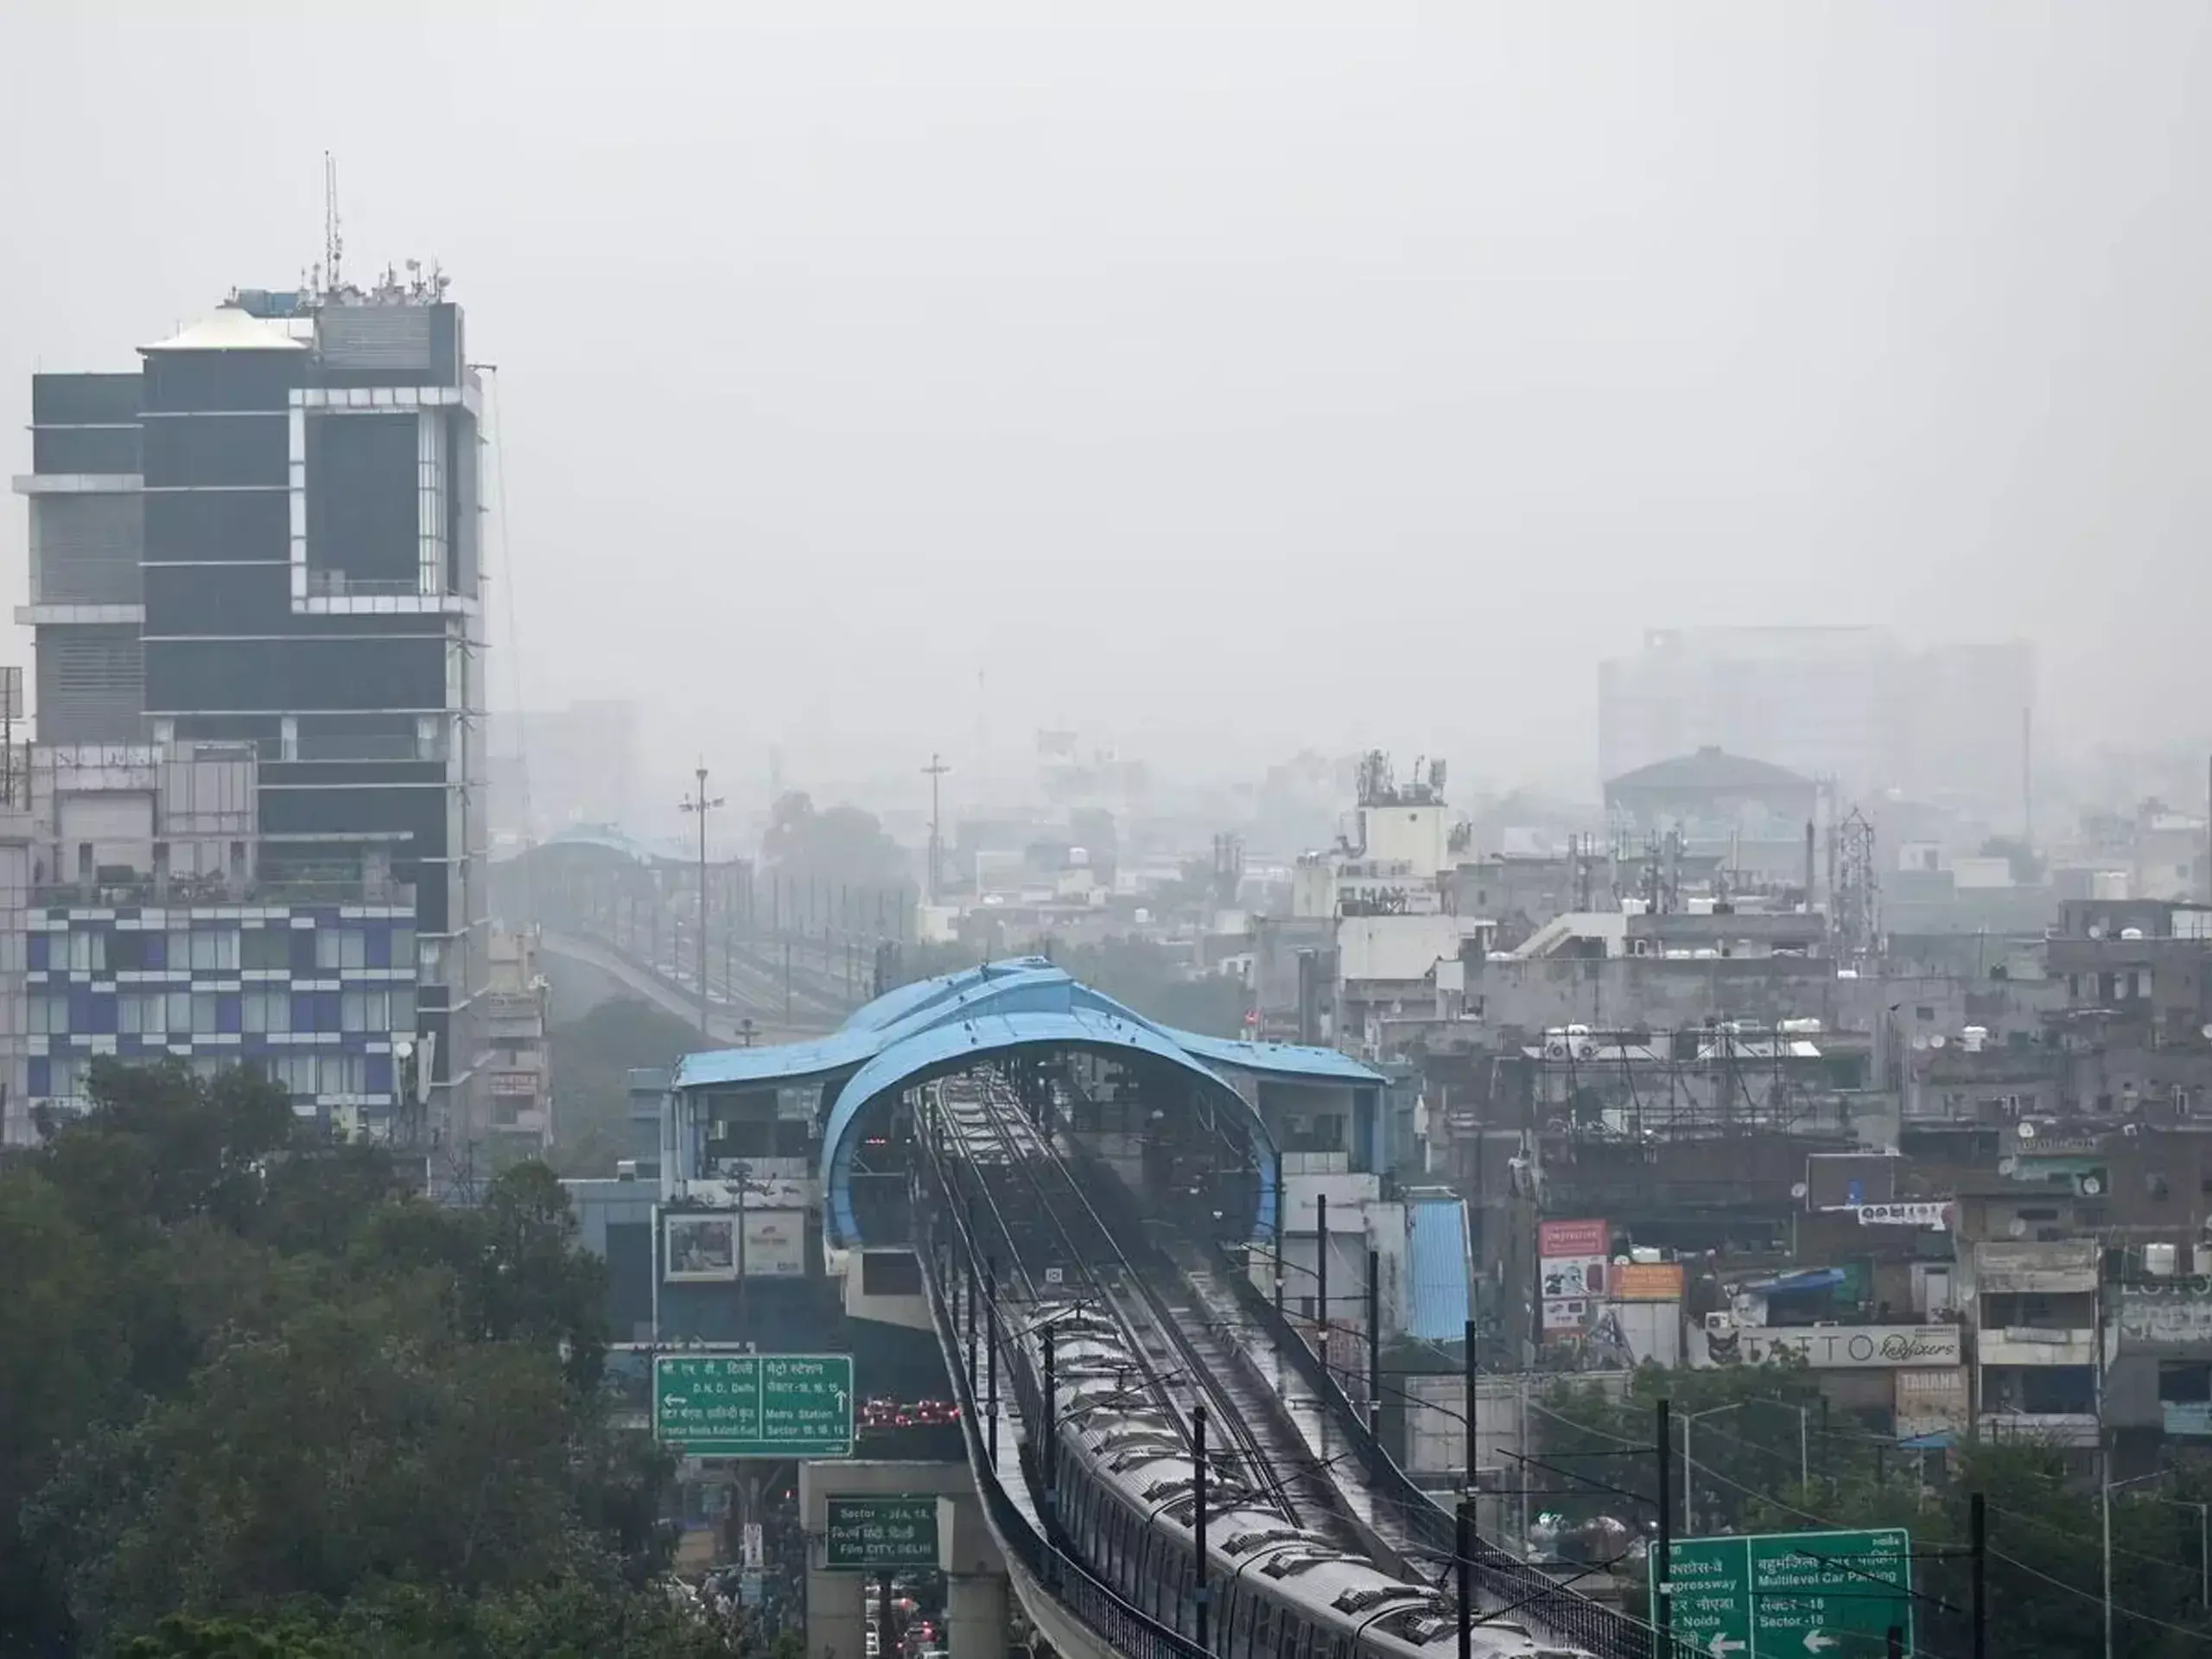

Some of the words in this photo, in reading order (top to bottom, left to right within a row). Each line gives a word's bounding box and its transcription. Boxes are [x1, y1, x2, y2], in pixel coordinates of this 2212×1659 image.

[798, 1408, 834, 1419] Station
[1758, 1573, 1819, 1586] Multilevel
[1821, 1571, 1845, 1584] Car
[1683, 1614, 1720, 1627] Noida
